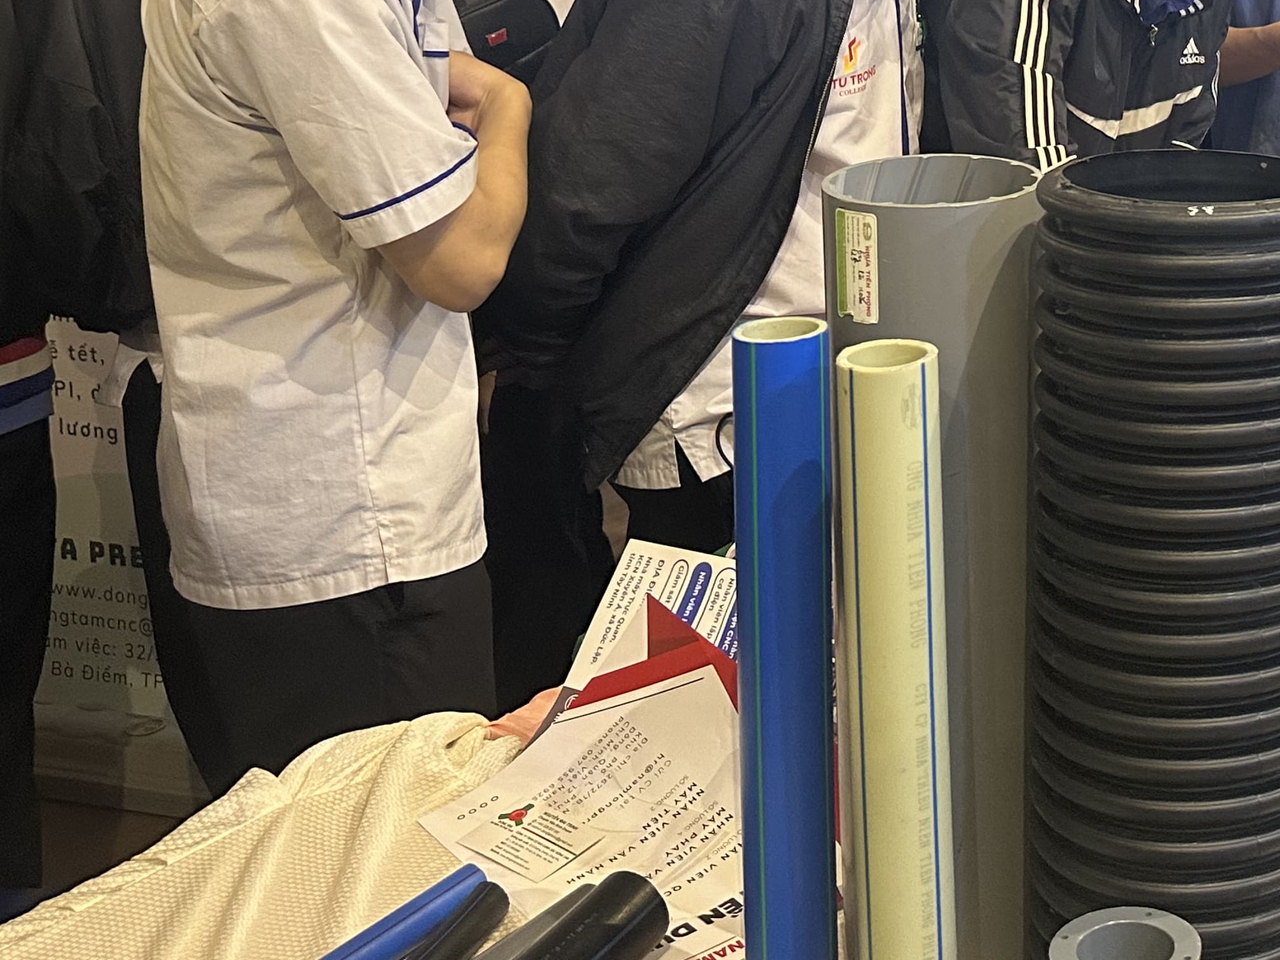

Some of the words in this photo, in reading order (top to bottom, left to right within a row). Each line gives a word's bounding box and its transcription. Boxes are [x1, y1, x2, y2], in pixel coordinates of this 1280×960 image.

[1180, 54, 1205, 65] adidas
[55, 380, 81, 401] PI,
[59, 417, 118, 445] lương
[89, 540, 144, 569] PRE
[632, 554, 644, 574] KCN
[692, 570, 707, 597] Nhân
[722, 578, 735, 603] Nhân
[52, 583, 148, 610] www.dong
[606, 588, 619, 609] Ninh
[683, 596, 697, 618] viên
[51, 610, 154, 637] ngtamcnc@
[713, 605, 724, 624] viên
[909, 598, 927, 649] PHONG
[721, 629, 735, 651] CNC
[51, 661, 74, 678] Bà
[624, 731, 643, 751] Khu
[581, 752, 665, 826] hr@namlongpr
[637, 778, 653, 795] CV
[673, 782, 697, 806] MÁY
[672, 788, 705, 820] NHÂN
[700, 813, 734, 844] NHÂN
[701, 807, 726, 830] MÁY
[639, 820, 669, 844] VIÊN
[664, 831, 698, 858] PHAY
[666, 844, 697, 868] VIÊN
[686, 861, 718, 885] VIÊN
